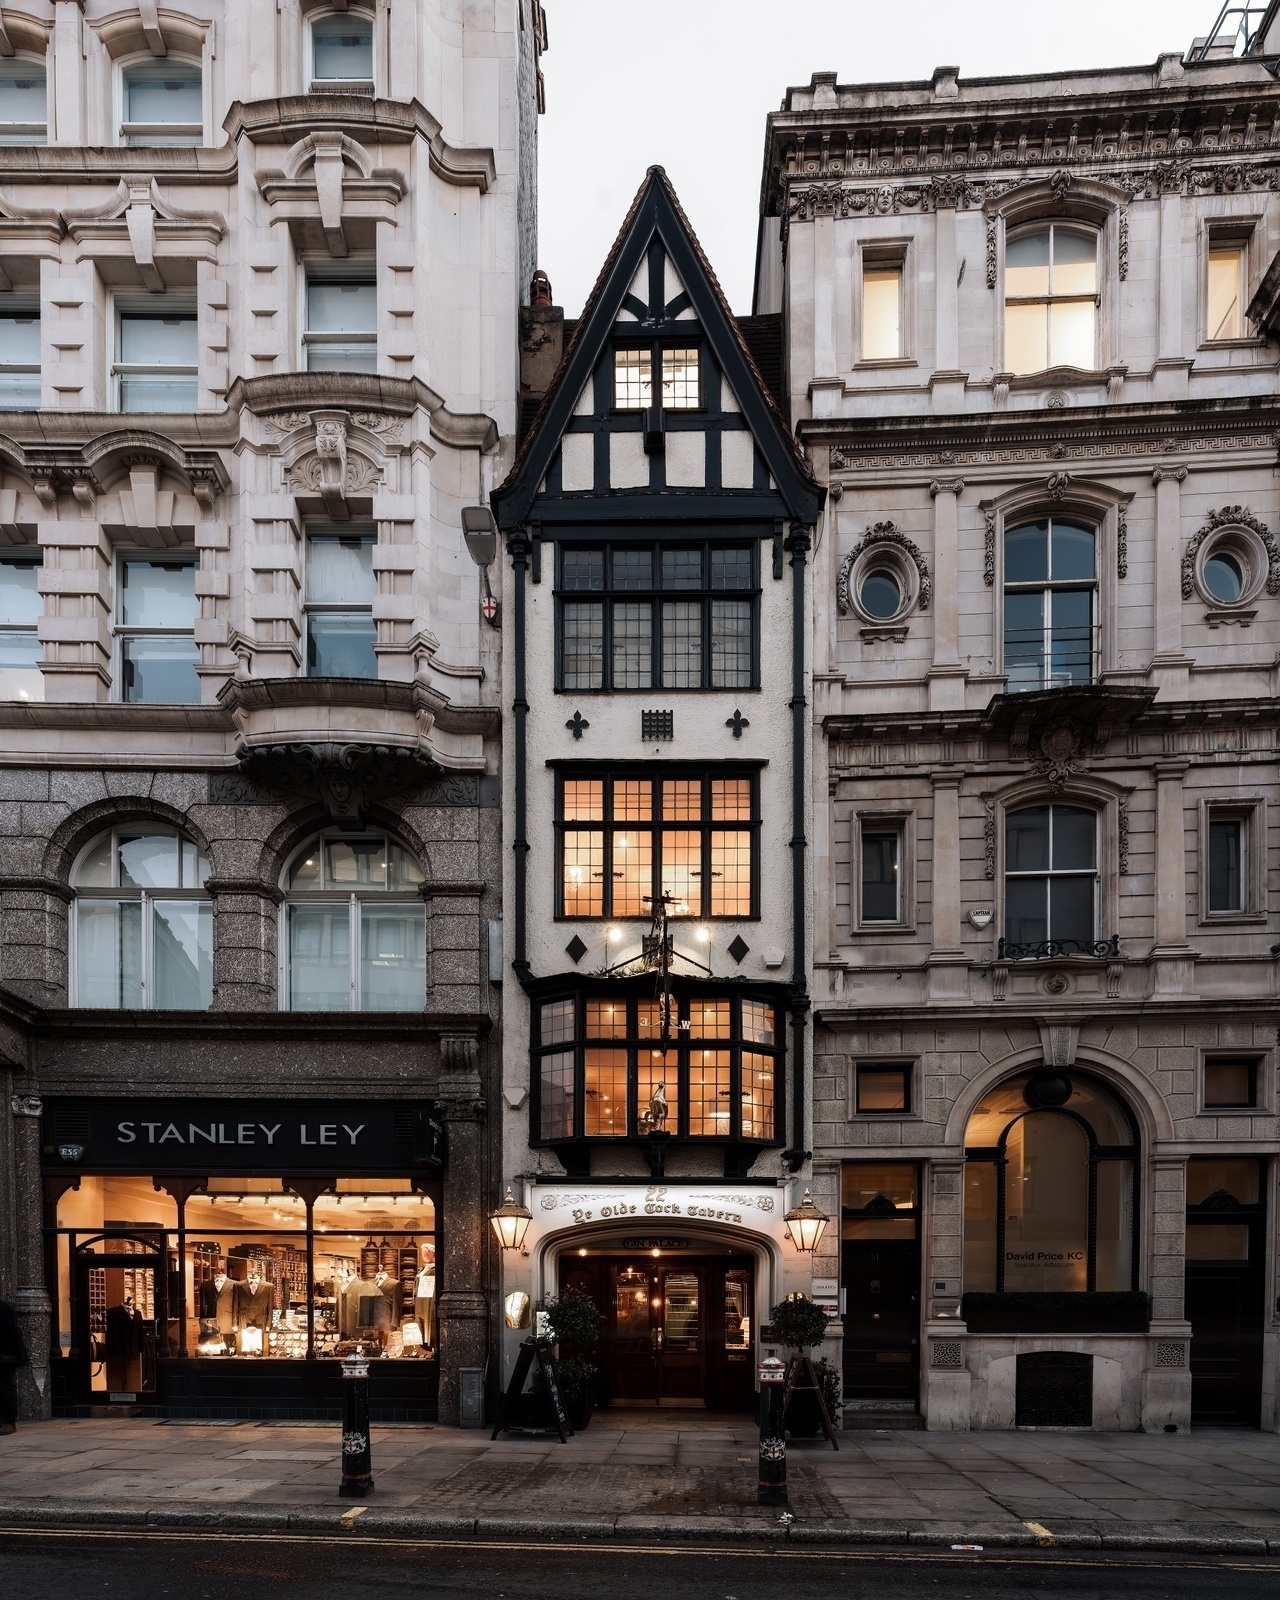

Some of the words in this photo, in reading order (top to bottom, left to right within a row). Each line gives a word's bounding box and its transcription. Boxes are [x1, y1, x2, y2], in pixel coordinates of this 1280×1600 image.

[118, 1122, 281, 1145] STANLEY
[301, 1123, 364, 1145] LEY
[61, 1148, 78, 1156] ESS
[645, 1185, 668, 1202] 22
[572, 1208, 592, 1224] Ye
[600, 1202, 636, 1217] Olde
[644, 1203, 682, 1215] Cock
[626, 1239, 644, 1247] GIN
[648, 1239, 684, 1247] PALACE
[1006, 1252, 1034, 1260] David
[1038, 1252, 1063, 1260] Price
[1067, 1252, 1083, 1260] KC
